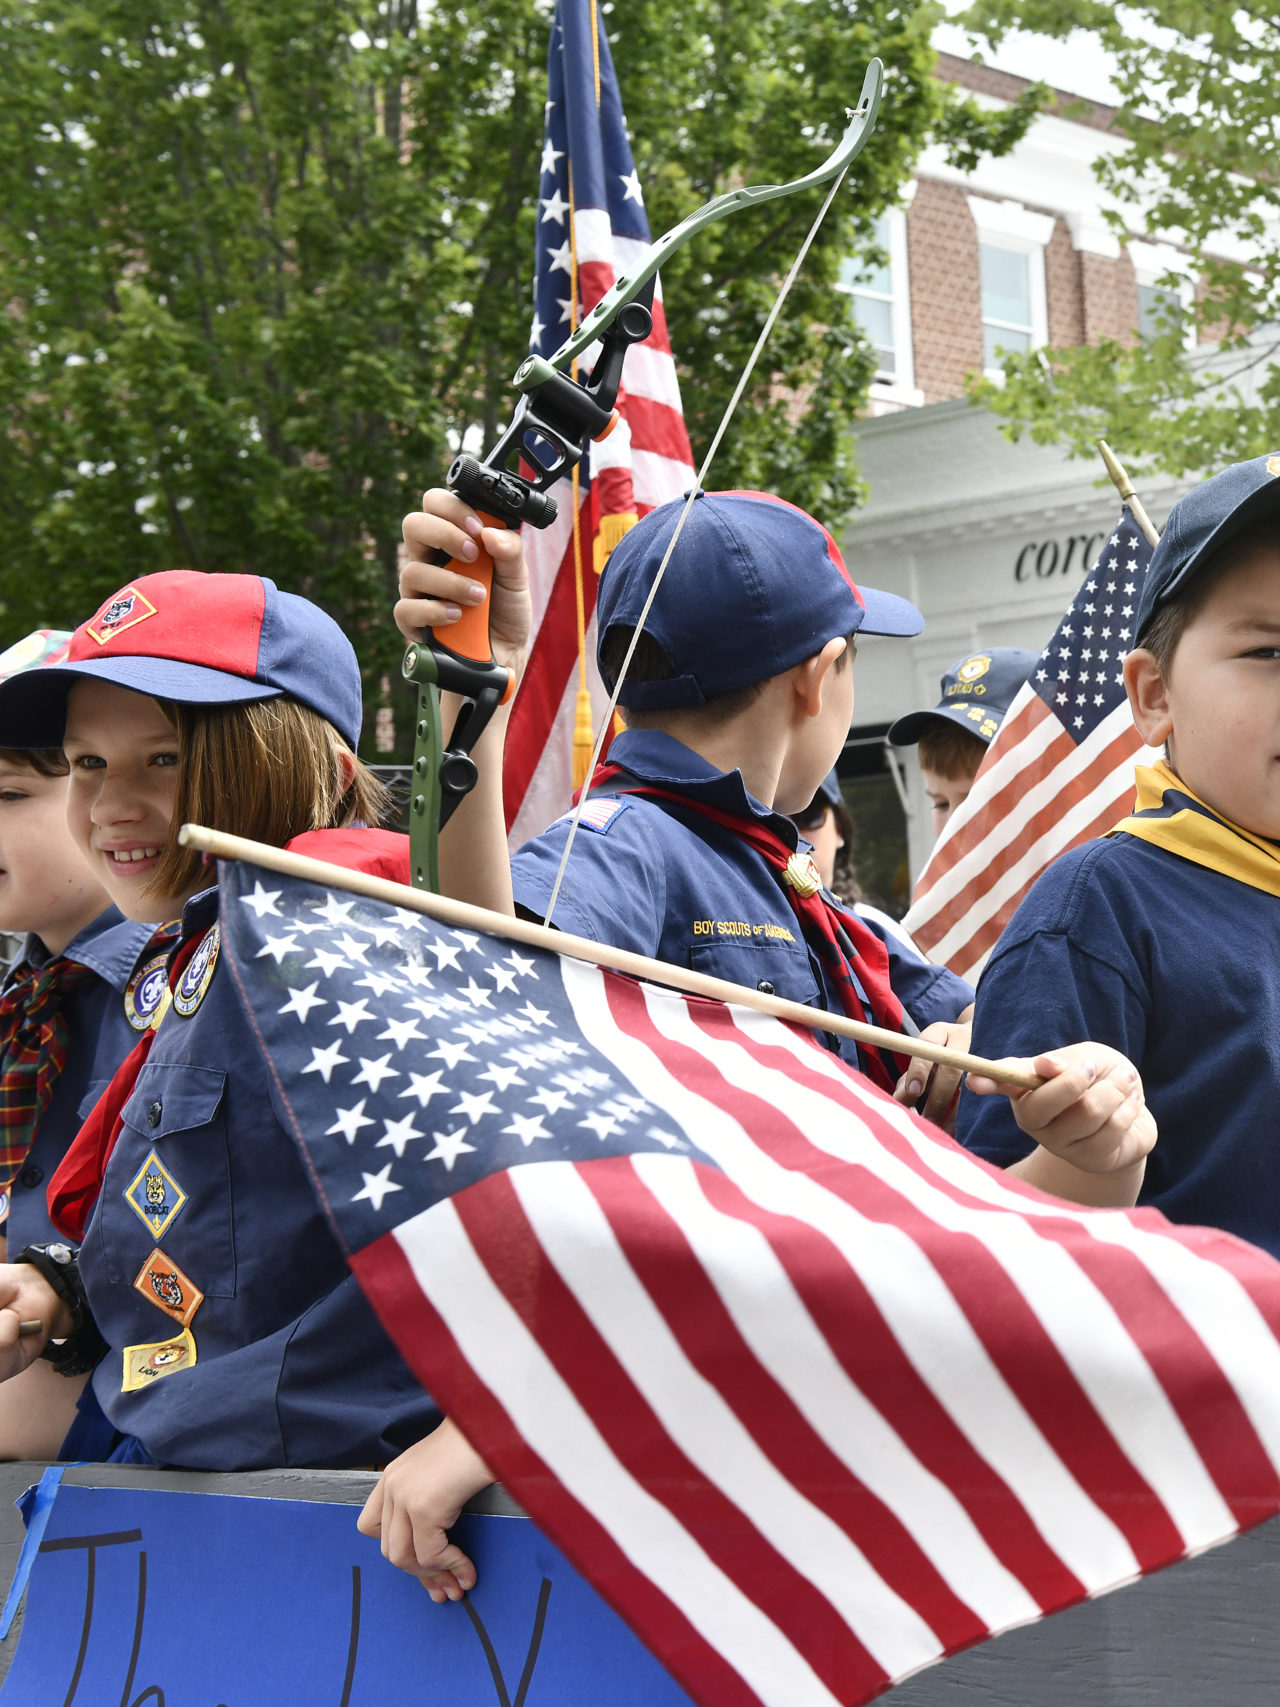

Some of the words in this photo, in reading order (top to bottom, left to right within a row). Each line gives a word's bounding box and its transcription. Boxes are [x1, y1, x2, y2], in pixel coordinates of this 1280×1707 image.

[693, 920, 715, 935] BOY
[717, 921, 752, 937] SCOUTS
[144, 1205, 170, 1216] BOBCAT
[138, 1366, 159, 1377] LION
